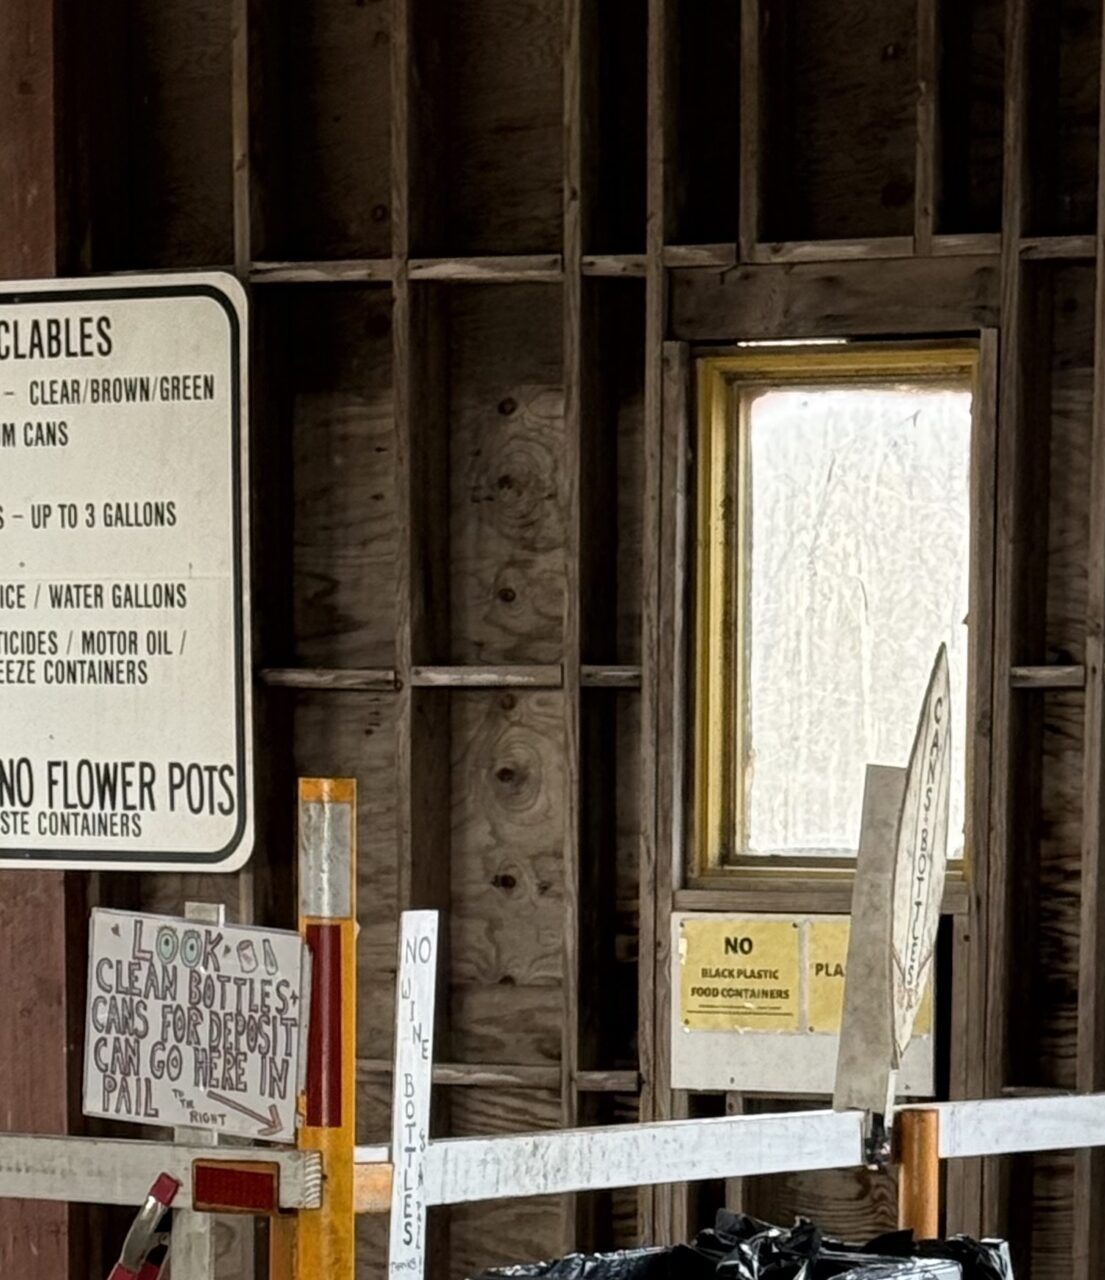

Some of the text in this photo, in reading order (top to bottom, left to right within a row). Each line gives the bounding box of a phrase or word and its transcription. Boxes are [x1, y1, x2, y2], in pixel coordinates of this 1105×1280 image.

[0, 315, 113, 360] CLABLES
[29, 374, 215, 406] CLEAR/BROWN/GREEN
[23, 420, 69, 447] CANS
[31, 503, 52, 529] UP
[57, 503, 78, 529] TO
[85, 502, 96, 528] 3
[103, 501, 177, 528] GALLONS
[0, 583, 26, 609] ICE
[48, 583, 104, 609] WATER
[111, 582, 188, 609] GALLONS
[81, 630, 139, 656] MOTOR
[146, 630, 174, 656] OIL
[44, 659, 149, 685] CONTAINERS
[0, 757, 236, 817] NO FLOWER POTS
[0, 809, 143, 838] STE CONTAINERS
[131, 919, 224, 973] LOOK
[405, 936, 432, 964] NO
[724, 936, 754, 955] NO
[96, 957, 178, 1002] CLEAN
[701, 967, 779, 981] BLACK PLASTIC
[690, 986, 790, 1000] FOOD CONTAINERS
[91, 995, 298, 1058] CANS FOR DEPOSIT
[93, 1036, 290, 1100] CAN GO HERE IN
[102, 1074, 160, 1118] PAIL
[189, 1109, 227, 1127] RIGHT
[403, 1072, 416, 1246] BOTTLES
